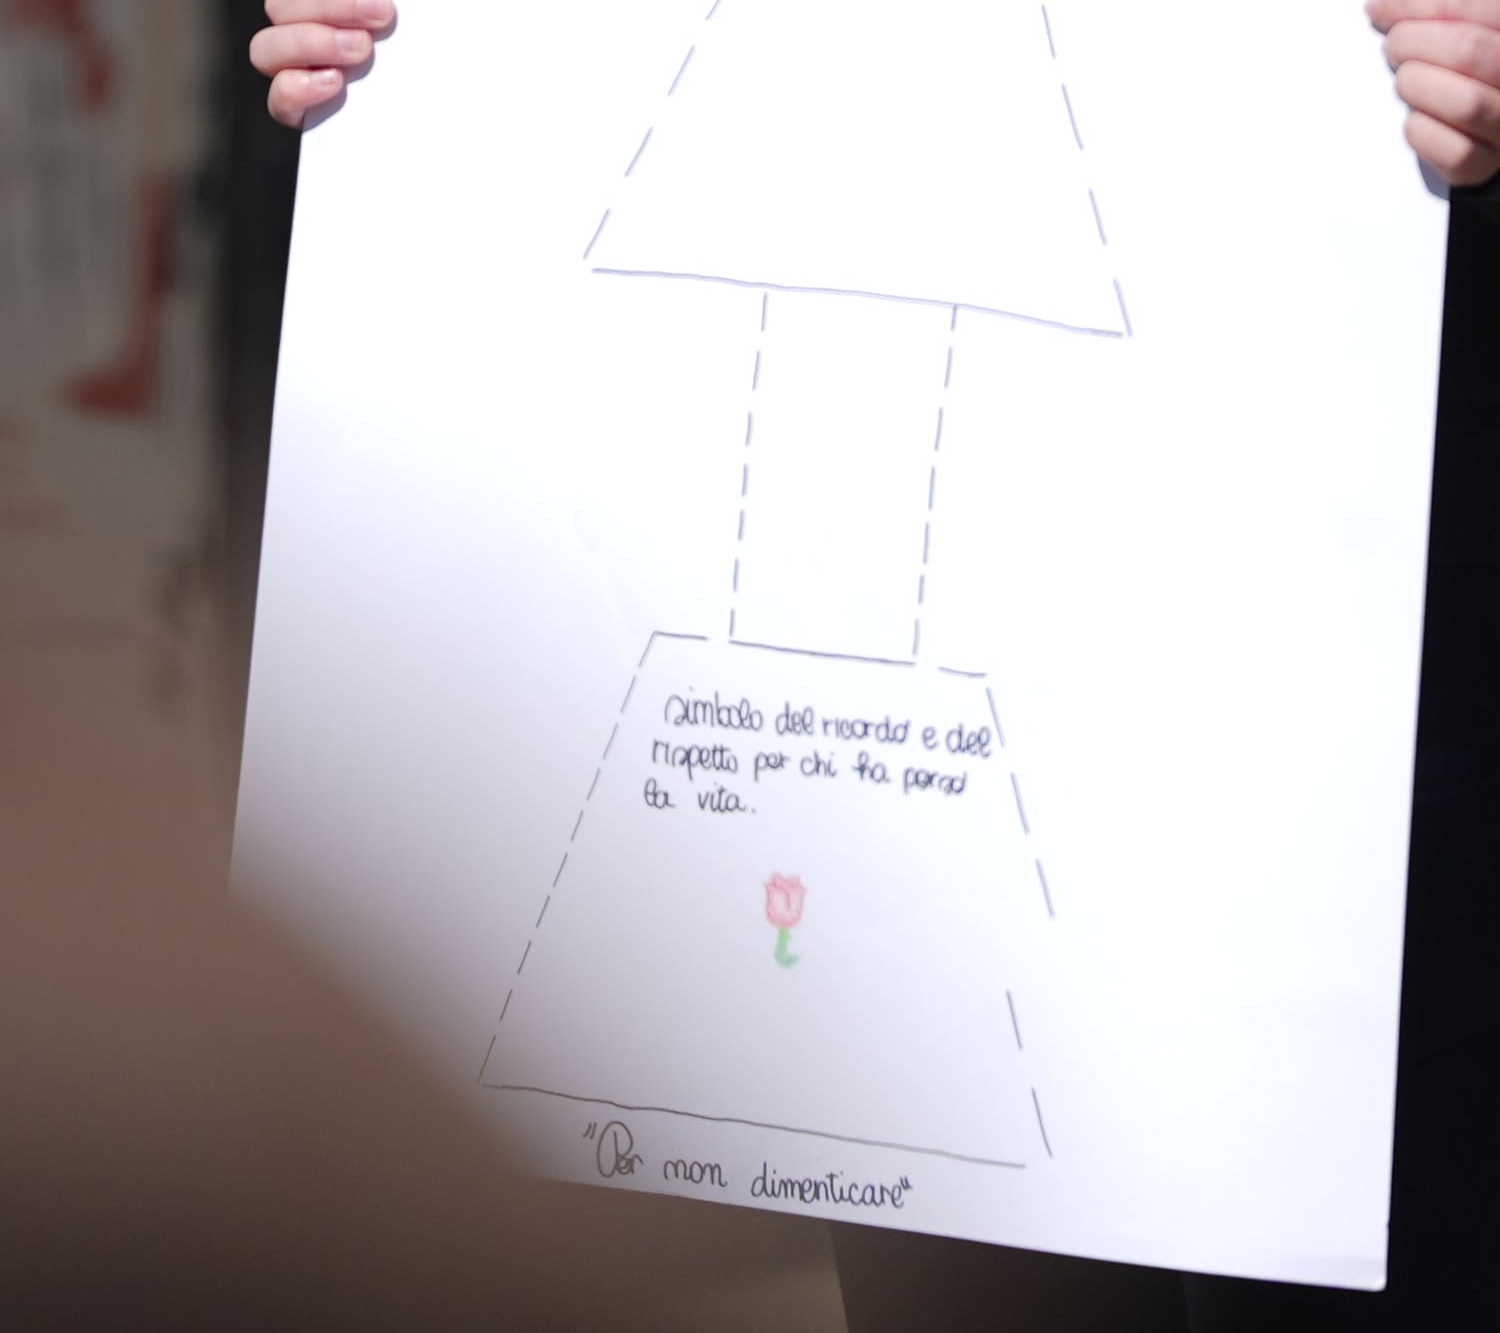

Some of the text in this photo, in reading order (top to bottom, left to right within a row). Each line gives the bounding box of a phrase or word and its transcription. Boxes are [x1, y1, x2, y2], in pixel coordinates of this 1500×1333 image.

[664, 686, 992, 759] simbolo del ricordo e del
[652, 738, 739, 783] rispetto
[754, 751, 791, 783] per
[799, 748, 837, 778] chi
[852, 750, 891, 784] ha
[644, 776, 757, 815] la vita.
